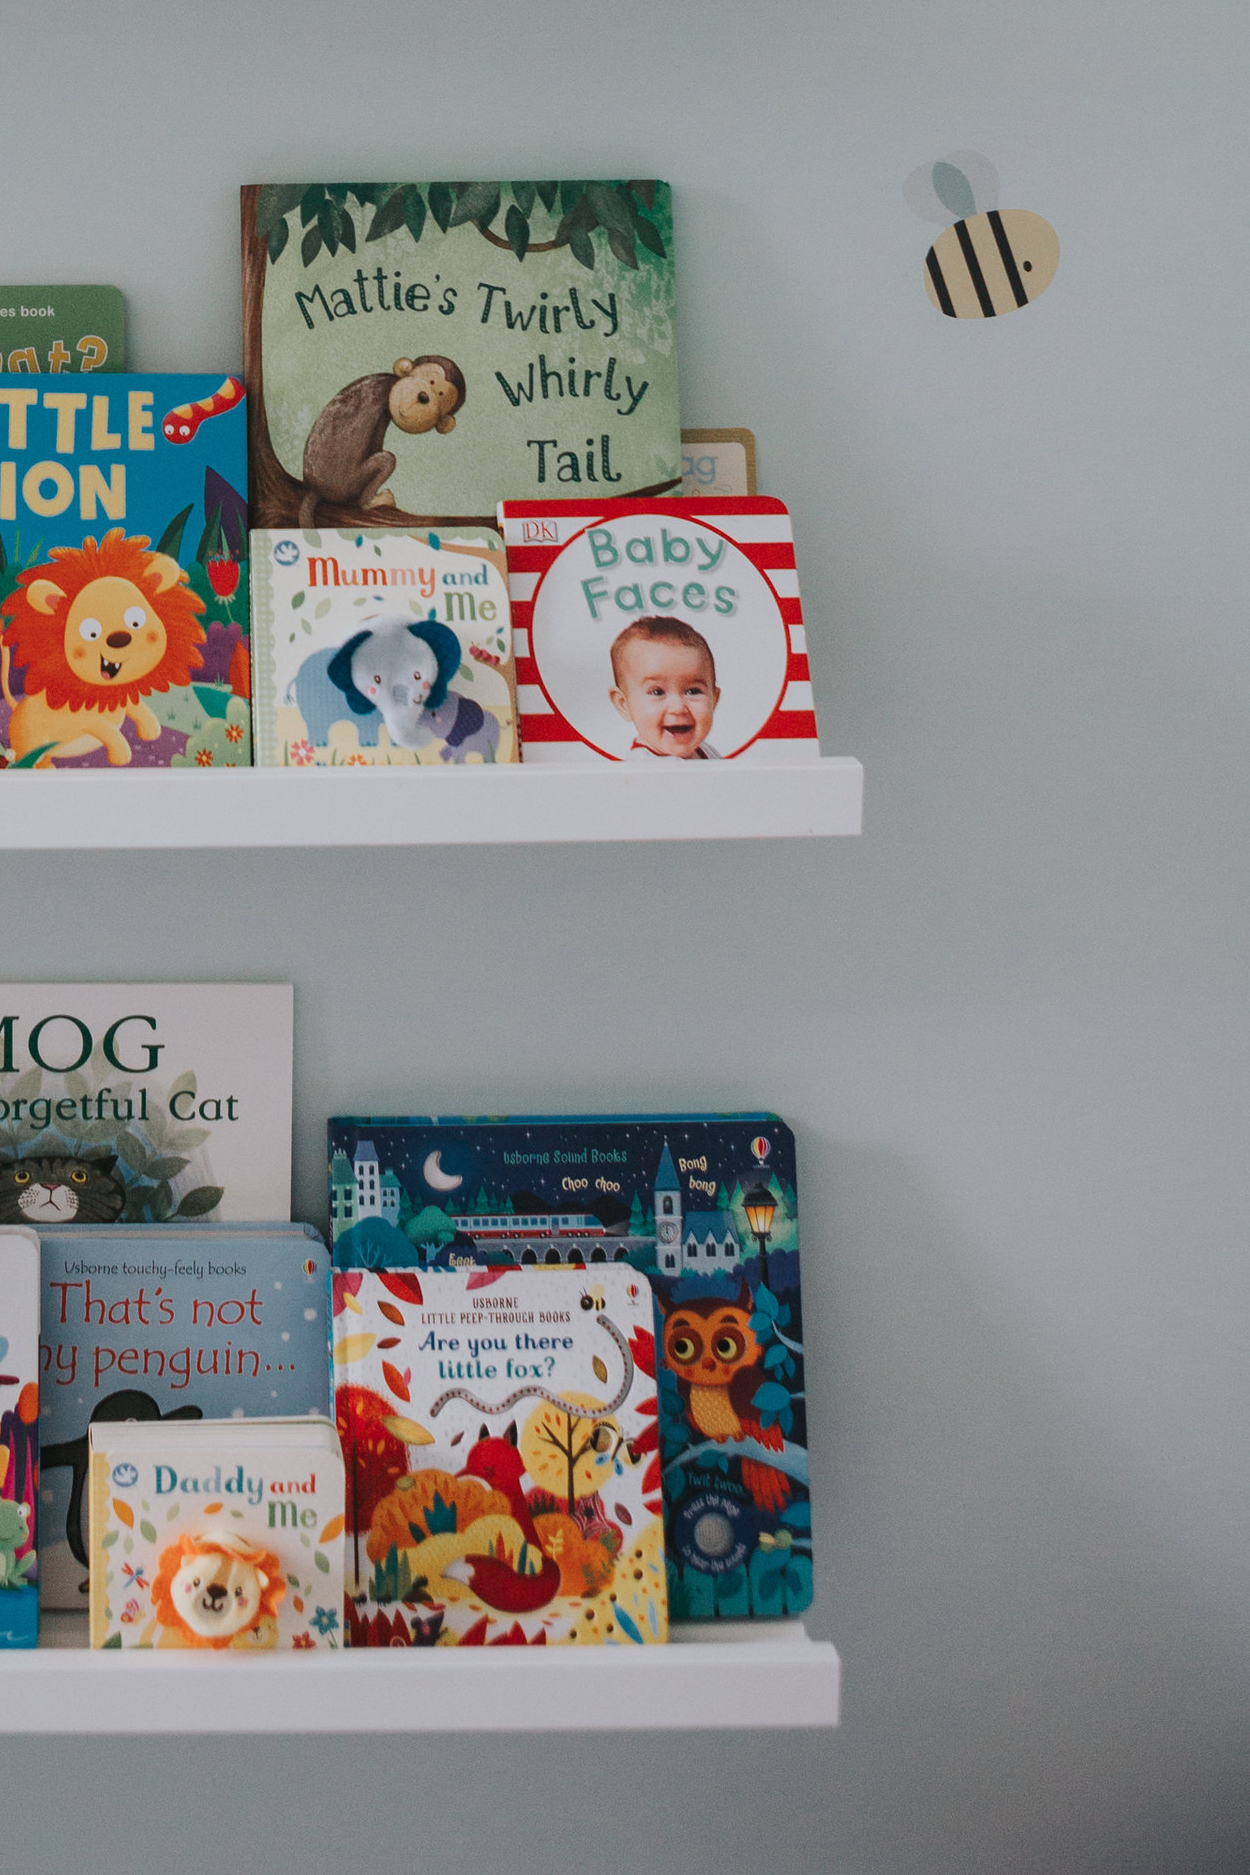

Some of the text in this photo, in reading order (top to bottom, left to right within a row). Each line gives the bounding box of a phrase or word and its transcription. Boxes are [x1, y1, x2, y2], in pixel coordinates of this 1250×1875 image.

[20, 306, 55, 318] book
[294, 266, 619, 337] Mattie's Twirly
[495, 354, 649, 415] Whirly
[527, 434, 622, 483] Tail
[526, 521, 554, 539] DK
[587, 528, 725, 571] Baby
[307, 557, 488, 598] Mummy and
[444, 591, 497, 622] Me
[581, 576, 736, 619] Faces
[169, 1091, 239, 1121] Cat
[503, 1147, 627, 1165] Usborne Sound Books
[678, 1155, 708, 1173] Bong
[561, 1176, 620, 1192] Choo choo
[688, 1175, 716, 1197] bong
[64, 1259, 247, 1279] Usborne touchy-feely books
[49, 1279, 263, 1327] That's not
[472, 1297, 519, 1309] USBORNE
[421, 1311, 571, 1324] LITTLE PEEP-THROUGH BOOKS
[419, 1331, 573, 1358] Are you there
[94, 1344, 296, 1389] penguin...
[438, 1357, 556, 1379] little fox?
[154, 1465, 316, 1505] Daddy and
[268, 1500, 318, 1528] Me
